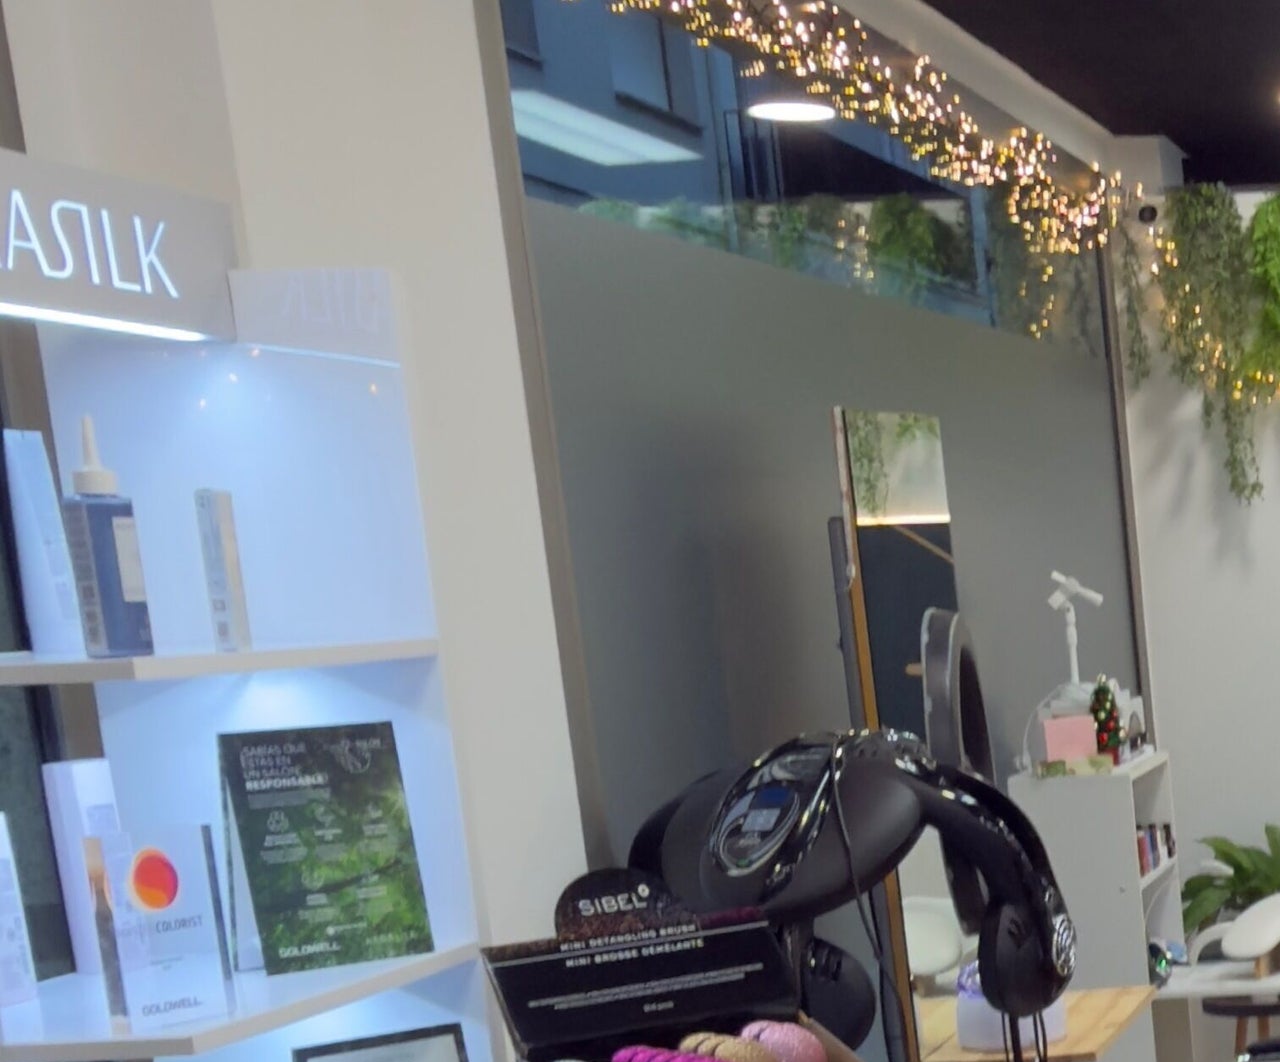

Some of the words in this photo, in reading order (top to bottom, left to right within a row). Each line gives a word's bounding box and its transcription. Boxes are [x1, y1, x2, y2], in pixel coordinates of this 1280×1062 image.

[0, 186, 181, 299] ASILK
[579, 892, 648, 916] SIBEL
[560, 941, 586, 952] MINI
[566, 956, 591, 968] MINI
